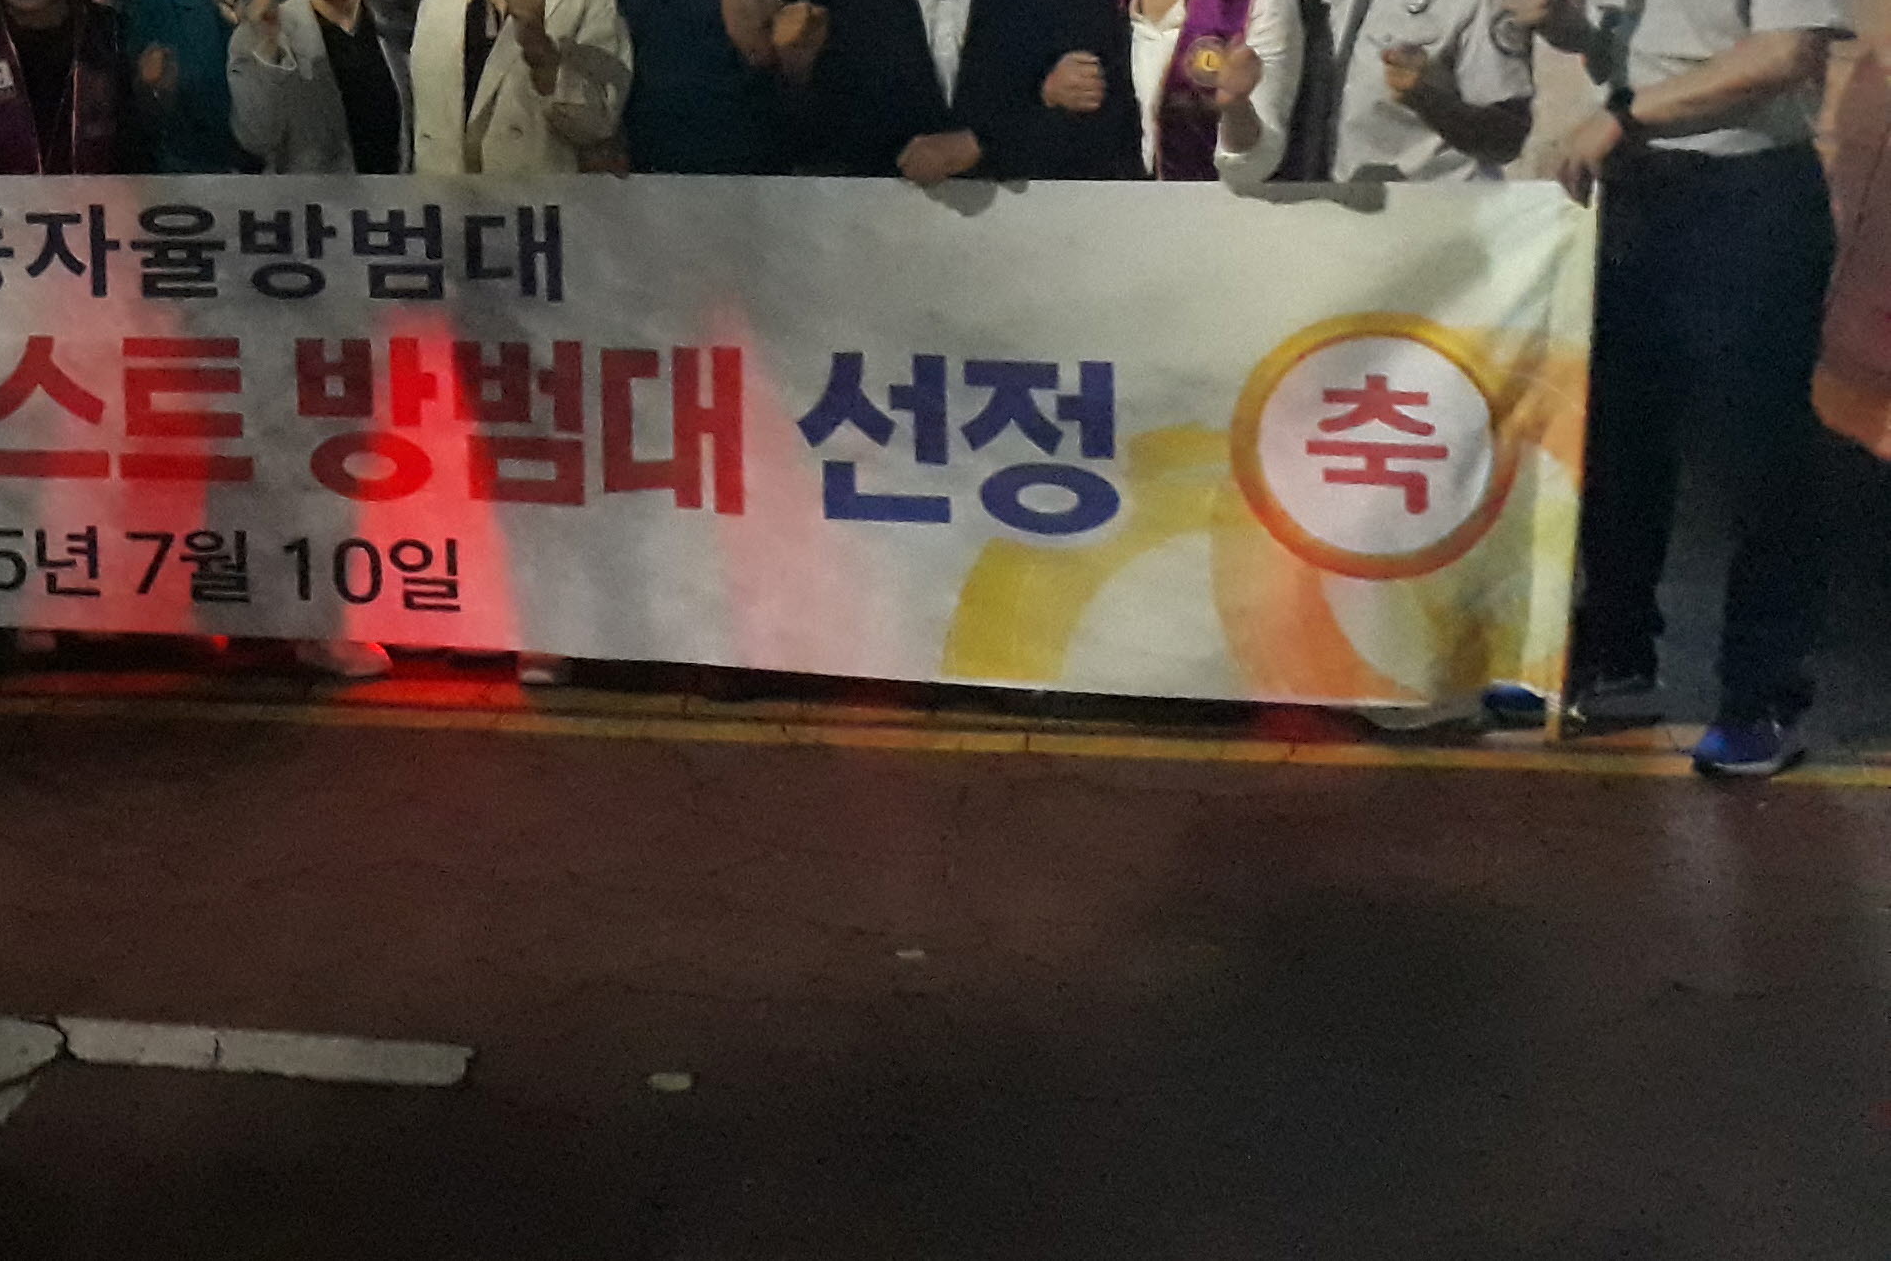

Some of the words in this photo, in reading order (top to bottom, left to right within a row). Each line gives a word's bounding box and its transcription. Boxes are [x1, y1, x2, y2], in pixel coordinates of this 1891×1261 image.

[296, 337, 746, 514] 방범대
[798, 351, 1121, 536] 선정
[1305, 375, 1449, 515] 축
[127, 531, 251, 604] 7월
[281, 538, 461, 612] 10일
